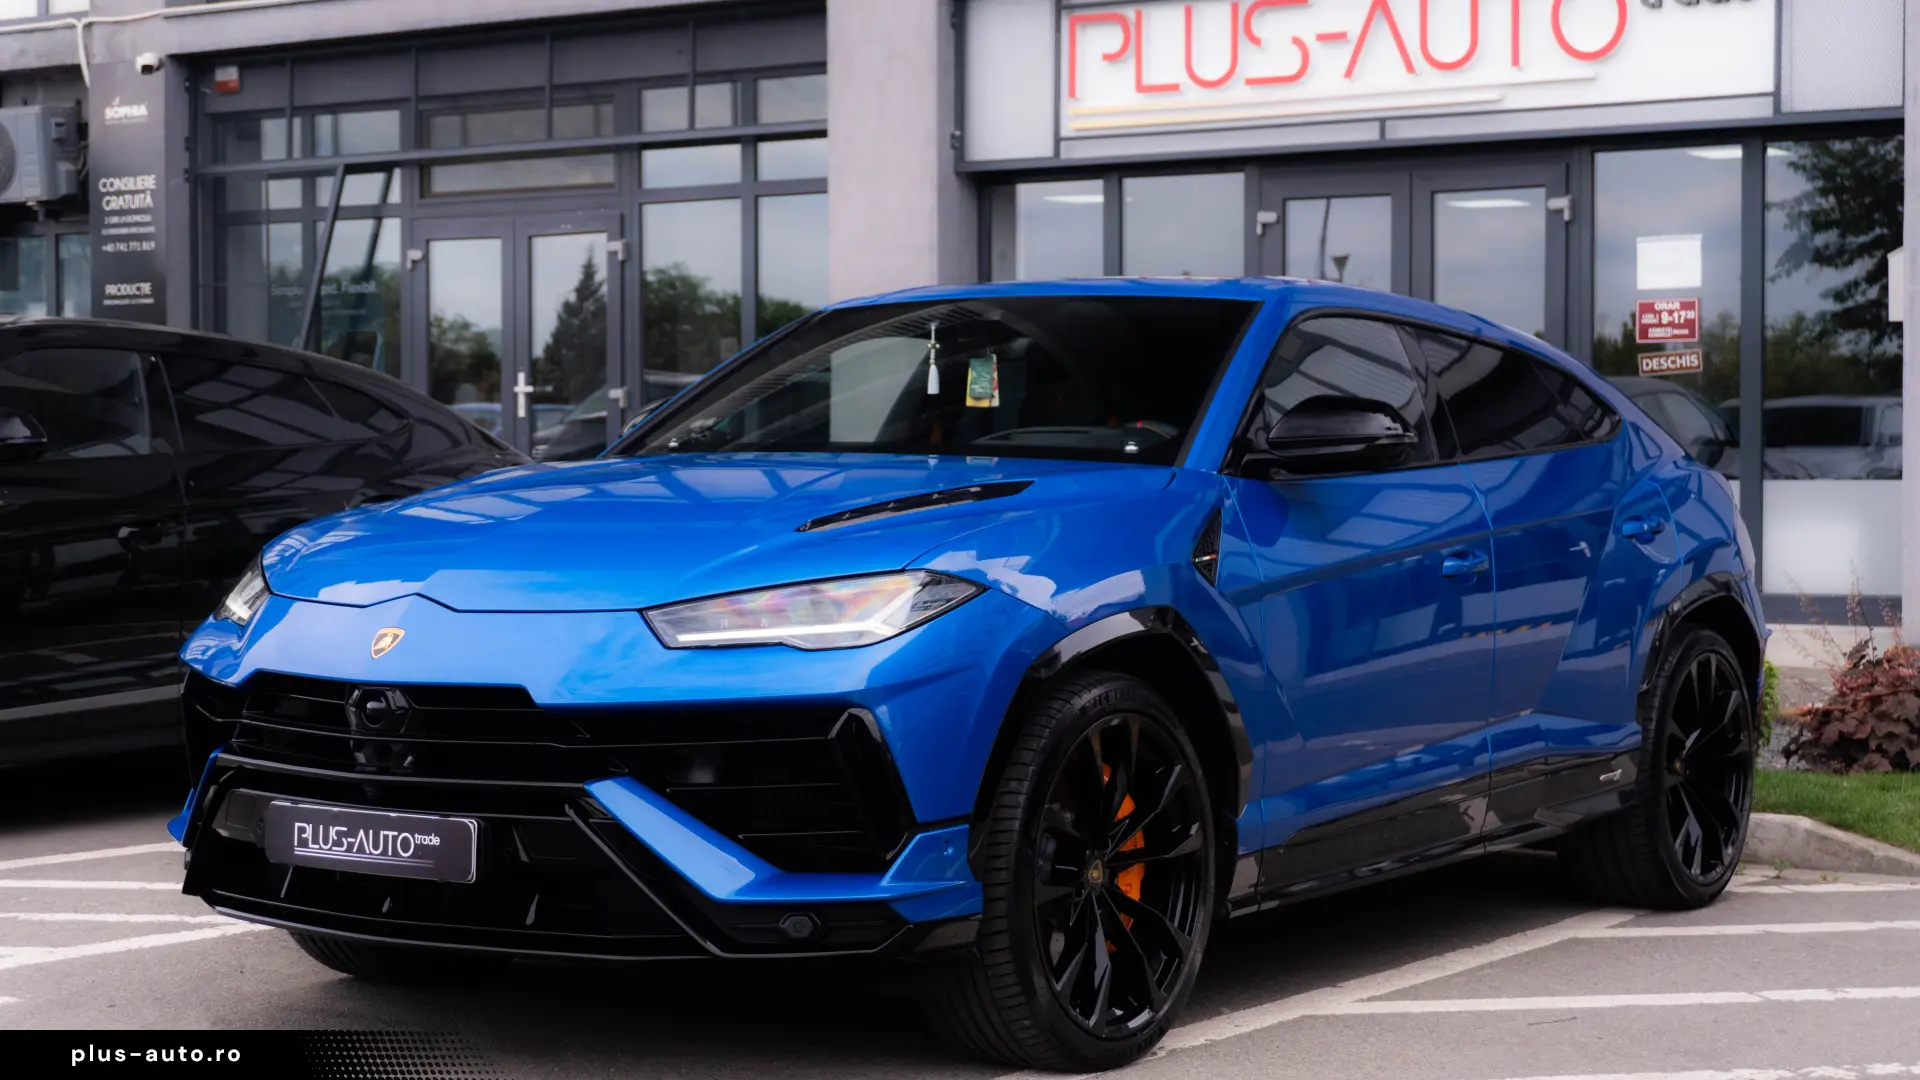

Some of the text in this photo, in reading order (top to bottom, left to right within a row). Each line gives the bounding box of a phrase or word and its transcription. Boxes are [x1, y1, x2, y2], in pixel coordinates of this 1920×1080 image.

[99, 175, 156, 192] CONSILIERE
[102, 191, 153, 210] GRATUITĂ
[1654, 302, 1680, 310] ORAR
[1642, 354, 1698, 371] DESCHIS
[294, 822, 441, 858] PLUS-AUTO trade
